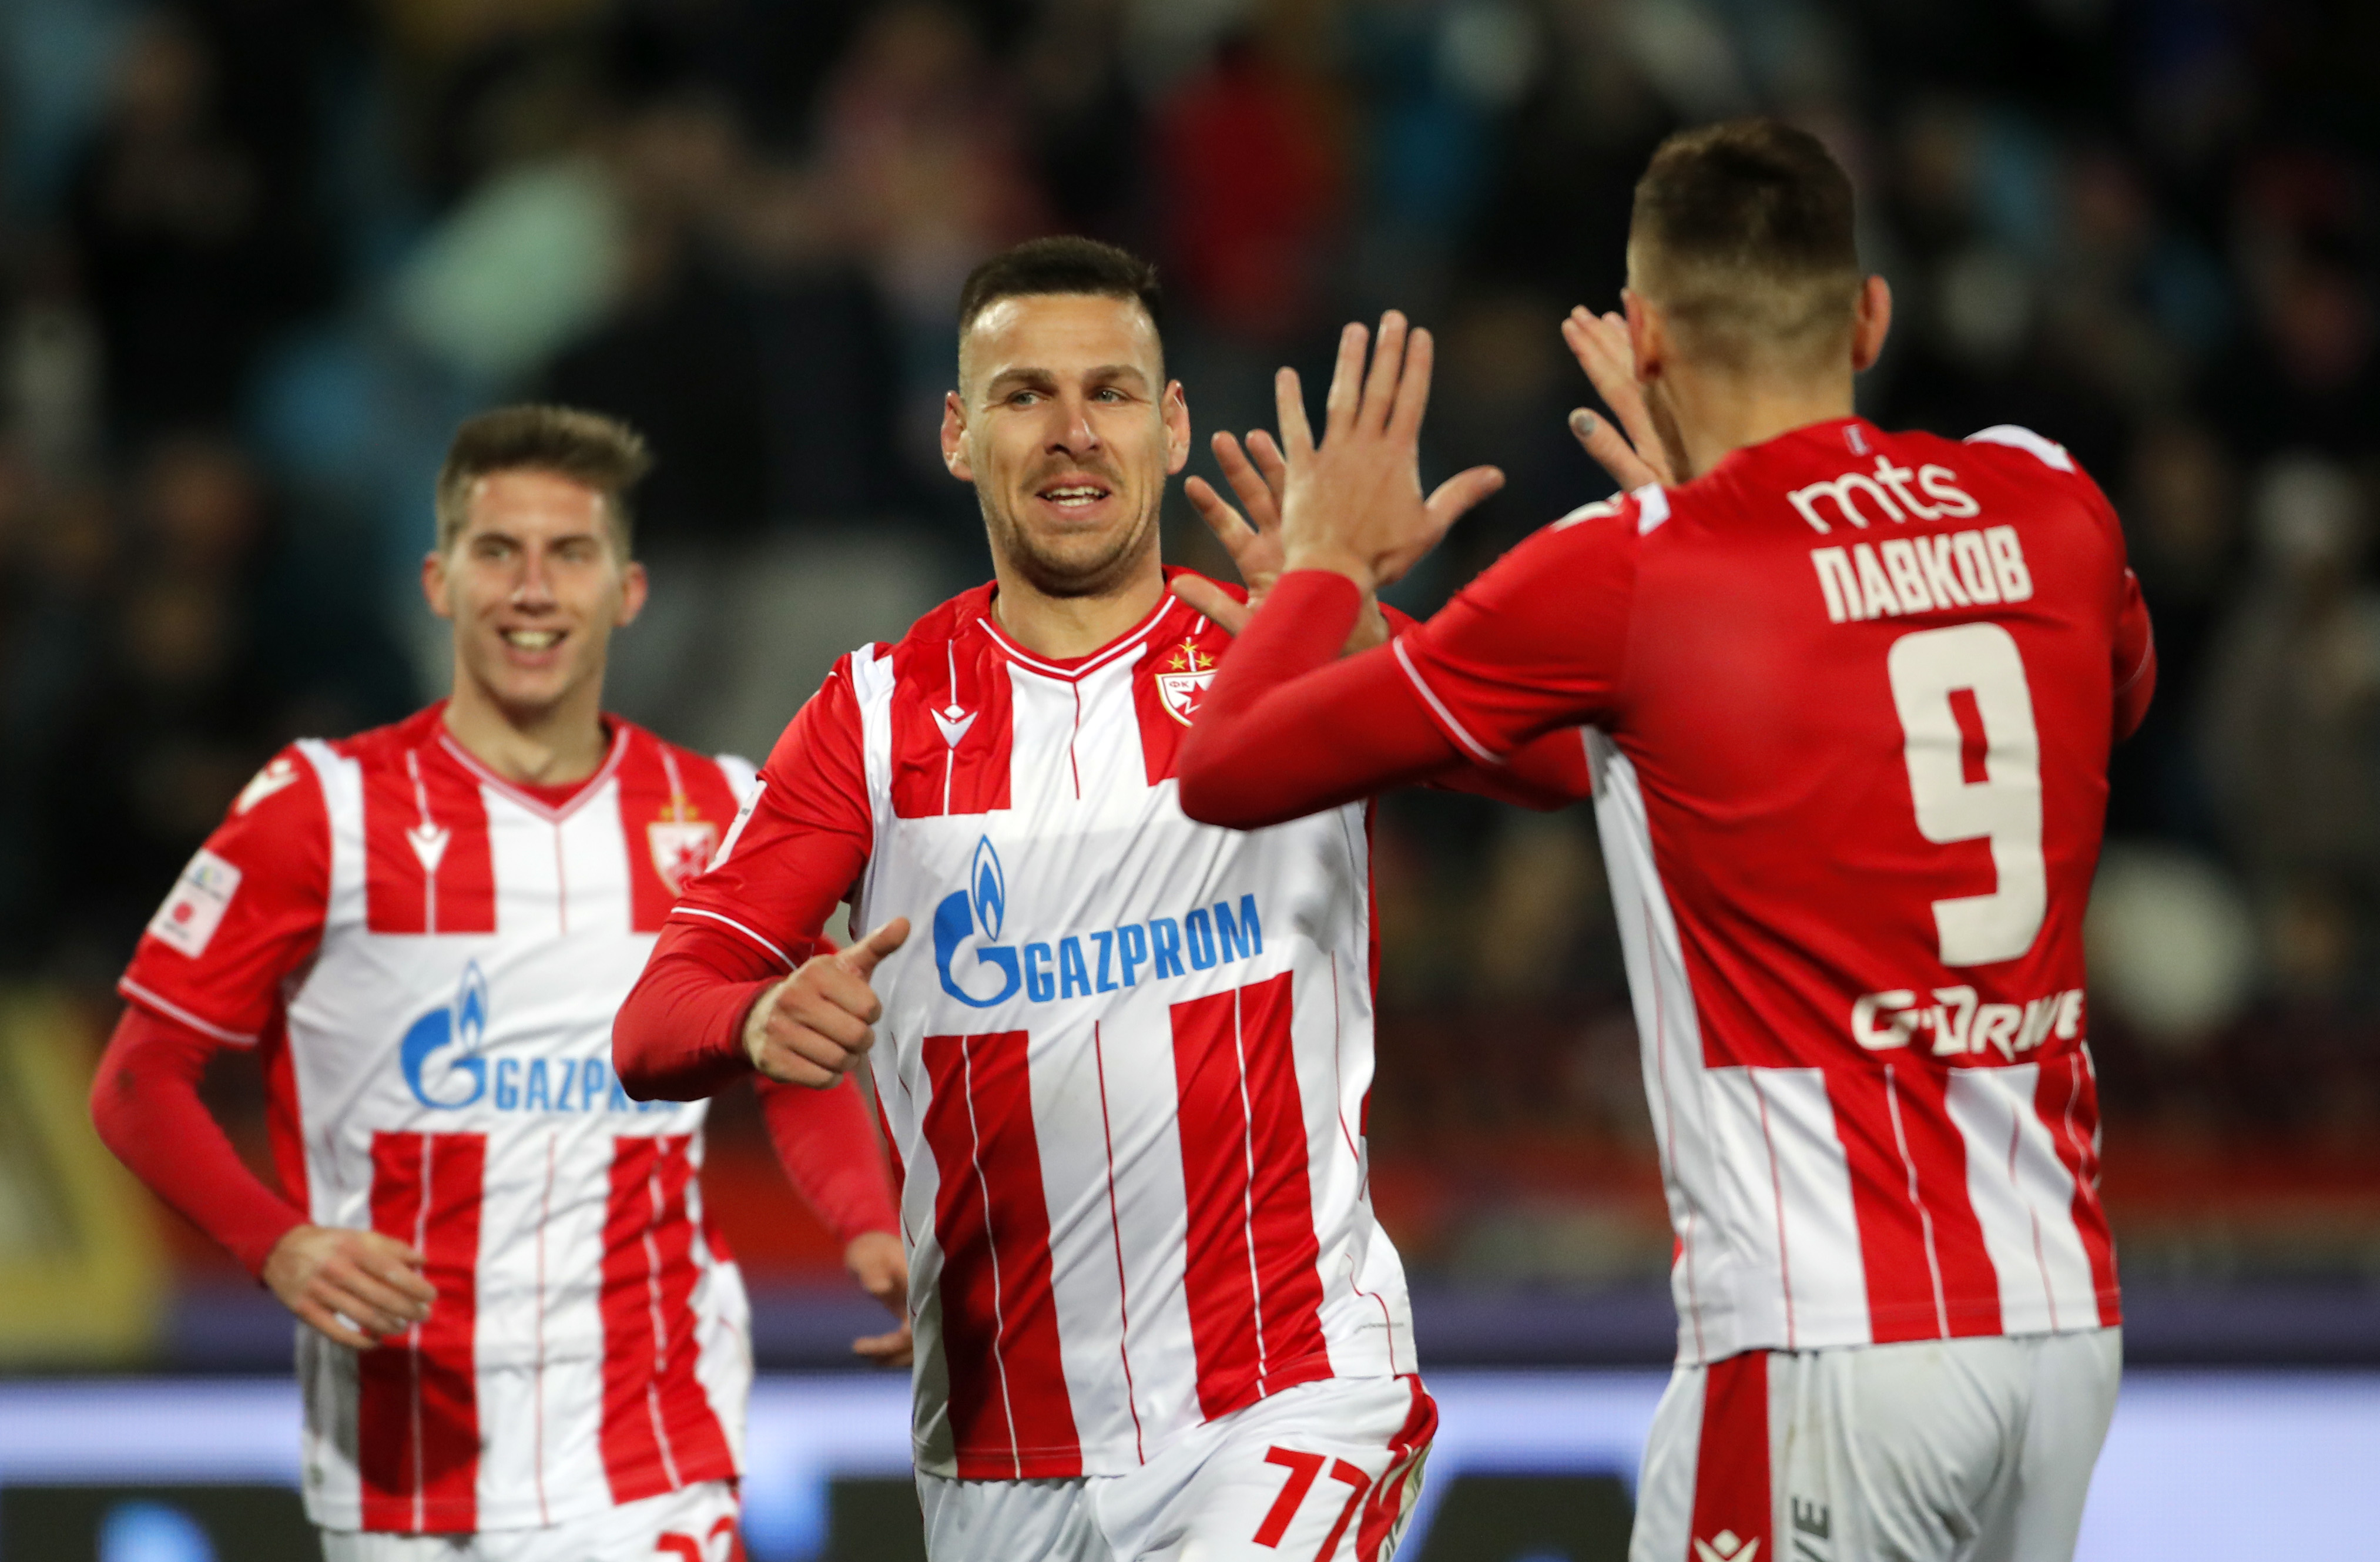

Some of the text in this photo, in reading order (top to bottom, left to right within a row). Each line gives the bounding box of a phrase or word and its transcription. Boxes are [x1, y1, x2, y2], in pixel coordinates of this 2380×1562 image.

[1787, 455, 1980, 534] mts
[1887, 622, 2047, 967] 9
[1024, 893, 1263, 1003] GAZPROM
[495, 1057, 685, 1113] GAZP
[1252, 1445, 1373, 1562] 77
